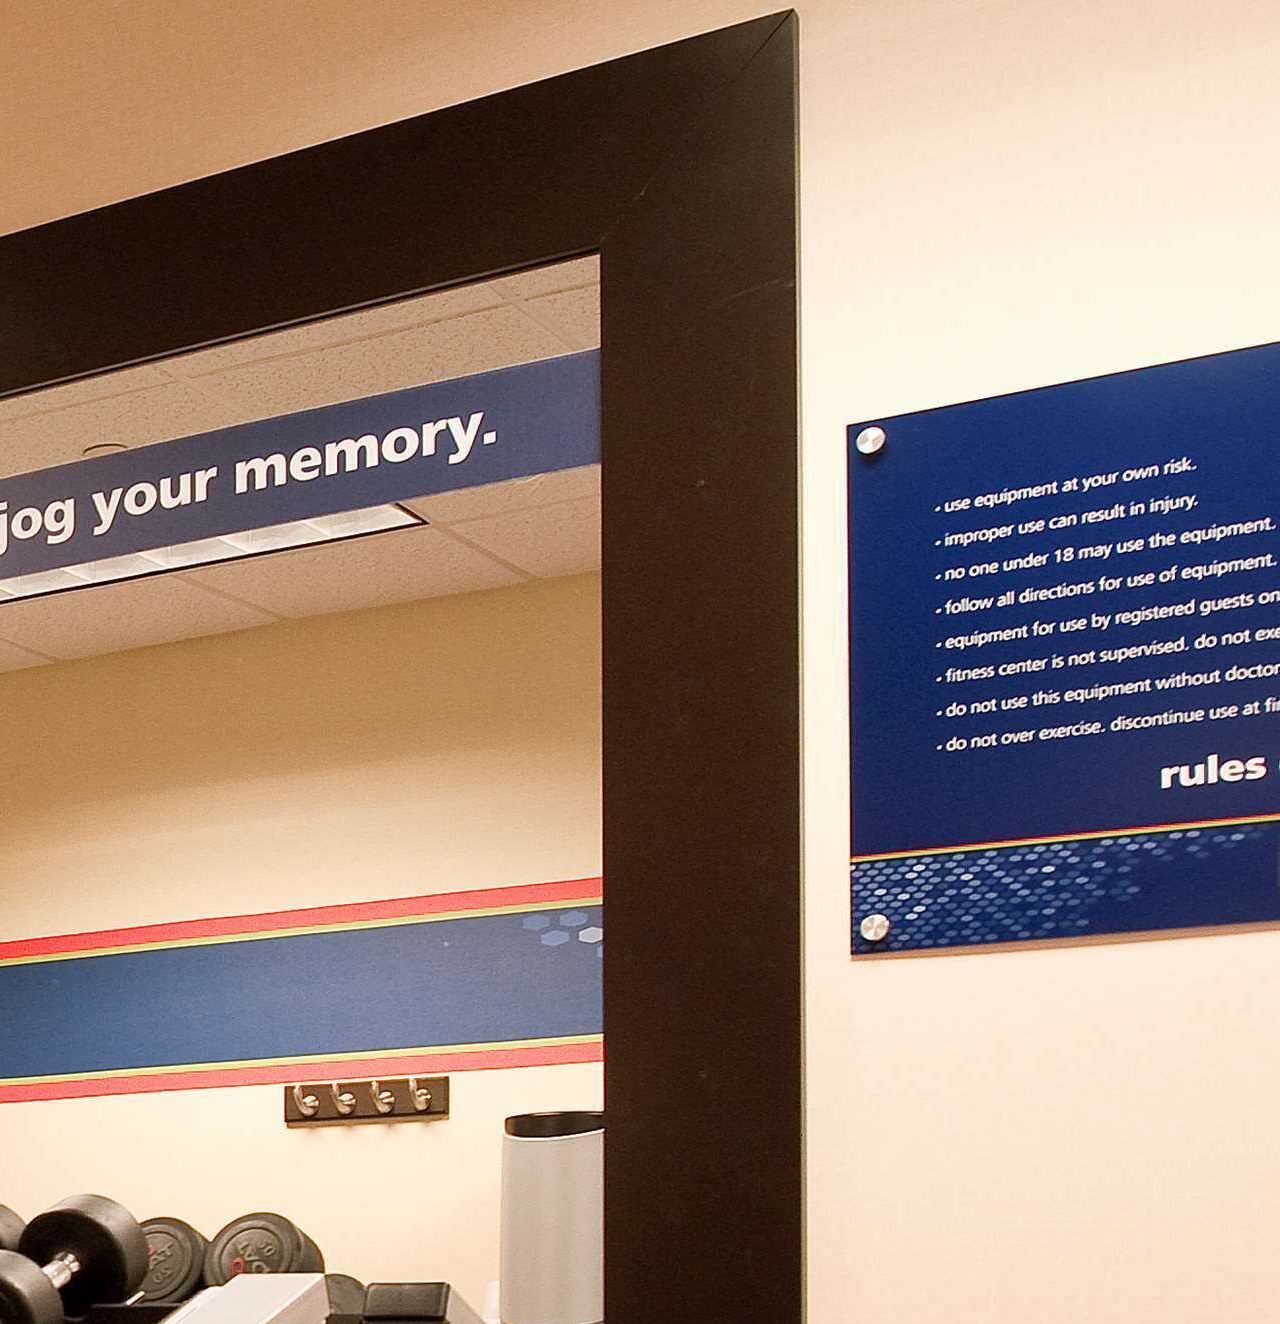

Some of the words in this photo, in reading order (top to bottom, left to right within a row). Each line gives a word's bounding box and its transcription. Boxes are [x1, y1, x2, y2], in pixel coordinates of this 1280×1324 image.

[91, 466, 218, 535] your
[235, 411, 497, 494] memory.
[944, 497, 971, 513] use
[974, 481, 1059, 508] equipment
[1061, 477, 1079, 492] at
[1081, 471, 1120, 493] your
[1122, 464, 1160, 482] own
[1163, 456, 1197, 475] risk.
[944, 524, 1015, 547] improper
[1018, 519, 1046, 535] use
[1048, 514, 1078, 530] can
[1081, 503, 1126, 524] result
[1129, 501, 1146, 516] in
[1149, 495, 1199, 515] injury.
[944, 567, 966, 581] no
[968, 562, 999, 577] one
[1002, 552, 1050, 572] under
[1054, 547, 1075, 563] 18
[1078, 543, 1113, 560] may
[1116, 538, 1145, 554] use
[1148, 532, 1177, 549] the
[1180, 517, 1277, 545] equipment.
[944, 597, 995, 615] follow
[996, 590, 1015, 607] all
[1018, 581, 1096, 604] directions
[1098, 575, 1123, 592] for
[1126, 572, 1156, 588] use
[1158, 564, 1178, 583] of
[1181, 553, 1278, 581] equipment.
[944, 625, 1029, 650] equipment
[1032, 620, 1057, 636] for
[1059, 618, 1088, 633] use
[1091, 613, 1112, 631] by
[1115, 598, 1196, 626] registered
[1199, 593, 1255, 616] guests
[945, 665, 995, 683] fitness
[997, 658, 1049, 676] center
[1051, 656, 1065, 669] is
[1068, 650, 1096, 666] not
[1099, 636, 1190, 663] supervised.
[1194, 633, 1218, 650] do
[1221, 629, 1251, 646] not
[945, 702, 967, 717] do
[970, 698, 997, 714] not
[1001, 696, 1029, 710] use
[1031, 689, 1061, 706] this
[1063, 678, 1152, 704] equipment
[1154, 669, 1221, 690] without
[945, 736, 968, 752] do
[970, 733, 998, 748] not
[1000, 729, 1036, 745] over
[1038, 720, 1106, 740] exercise.
[1110, 709, 1205, 732] discontinue
[1208, 705, 1239, 720] use
[1241, 701, 1261, 716] at
[1160, 753, 1268, 789] rules
